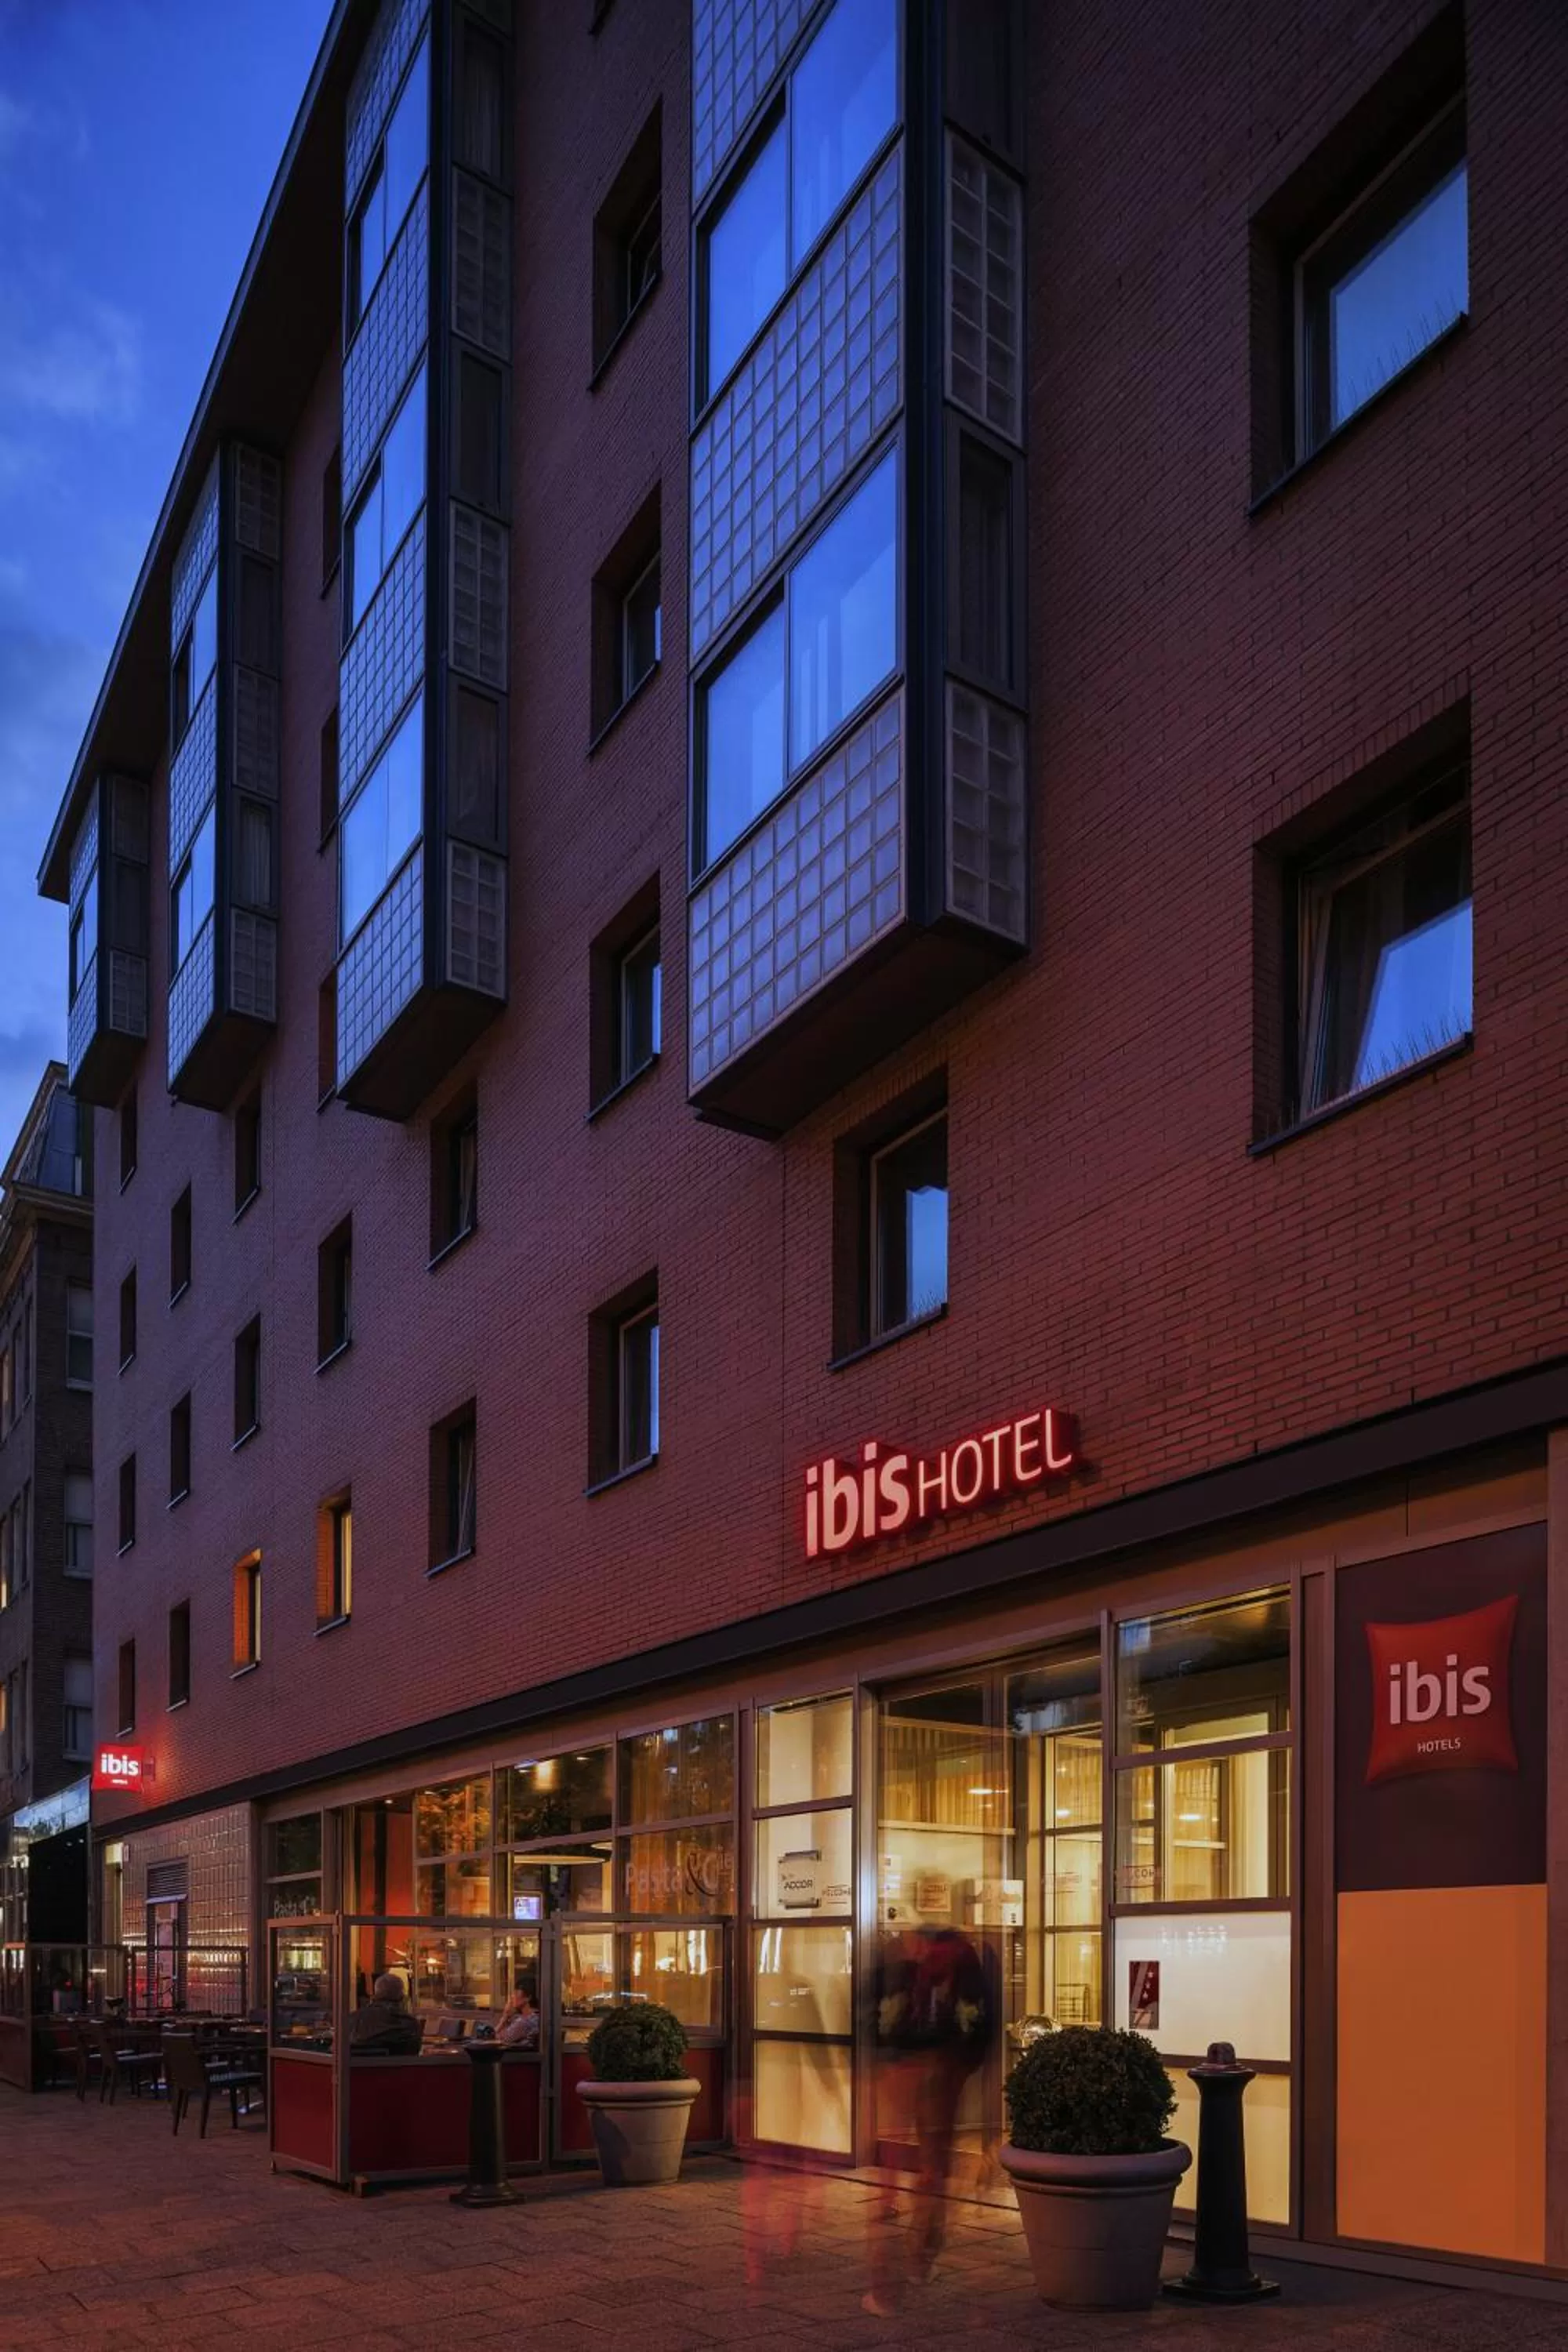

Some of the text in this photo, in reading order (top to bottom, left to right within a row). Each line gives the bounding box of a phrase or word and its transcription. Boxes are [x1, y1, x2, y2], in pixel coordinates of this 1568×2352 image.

[806, 1409, 1072, 1557] ibis HOTEL
[1389, 1653, 1492, 1725] ibis
[1417, 1737, 1461, 1753] HOTELS
[101, 1753, 139, 1777] ibis
[626, 1858, 683, 1895] Pasta
